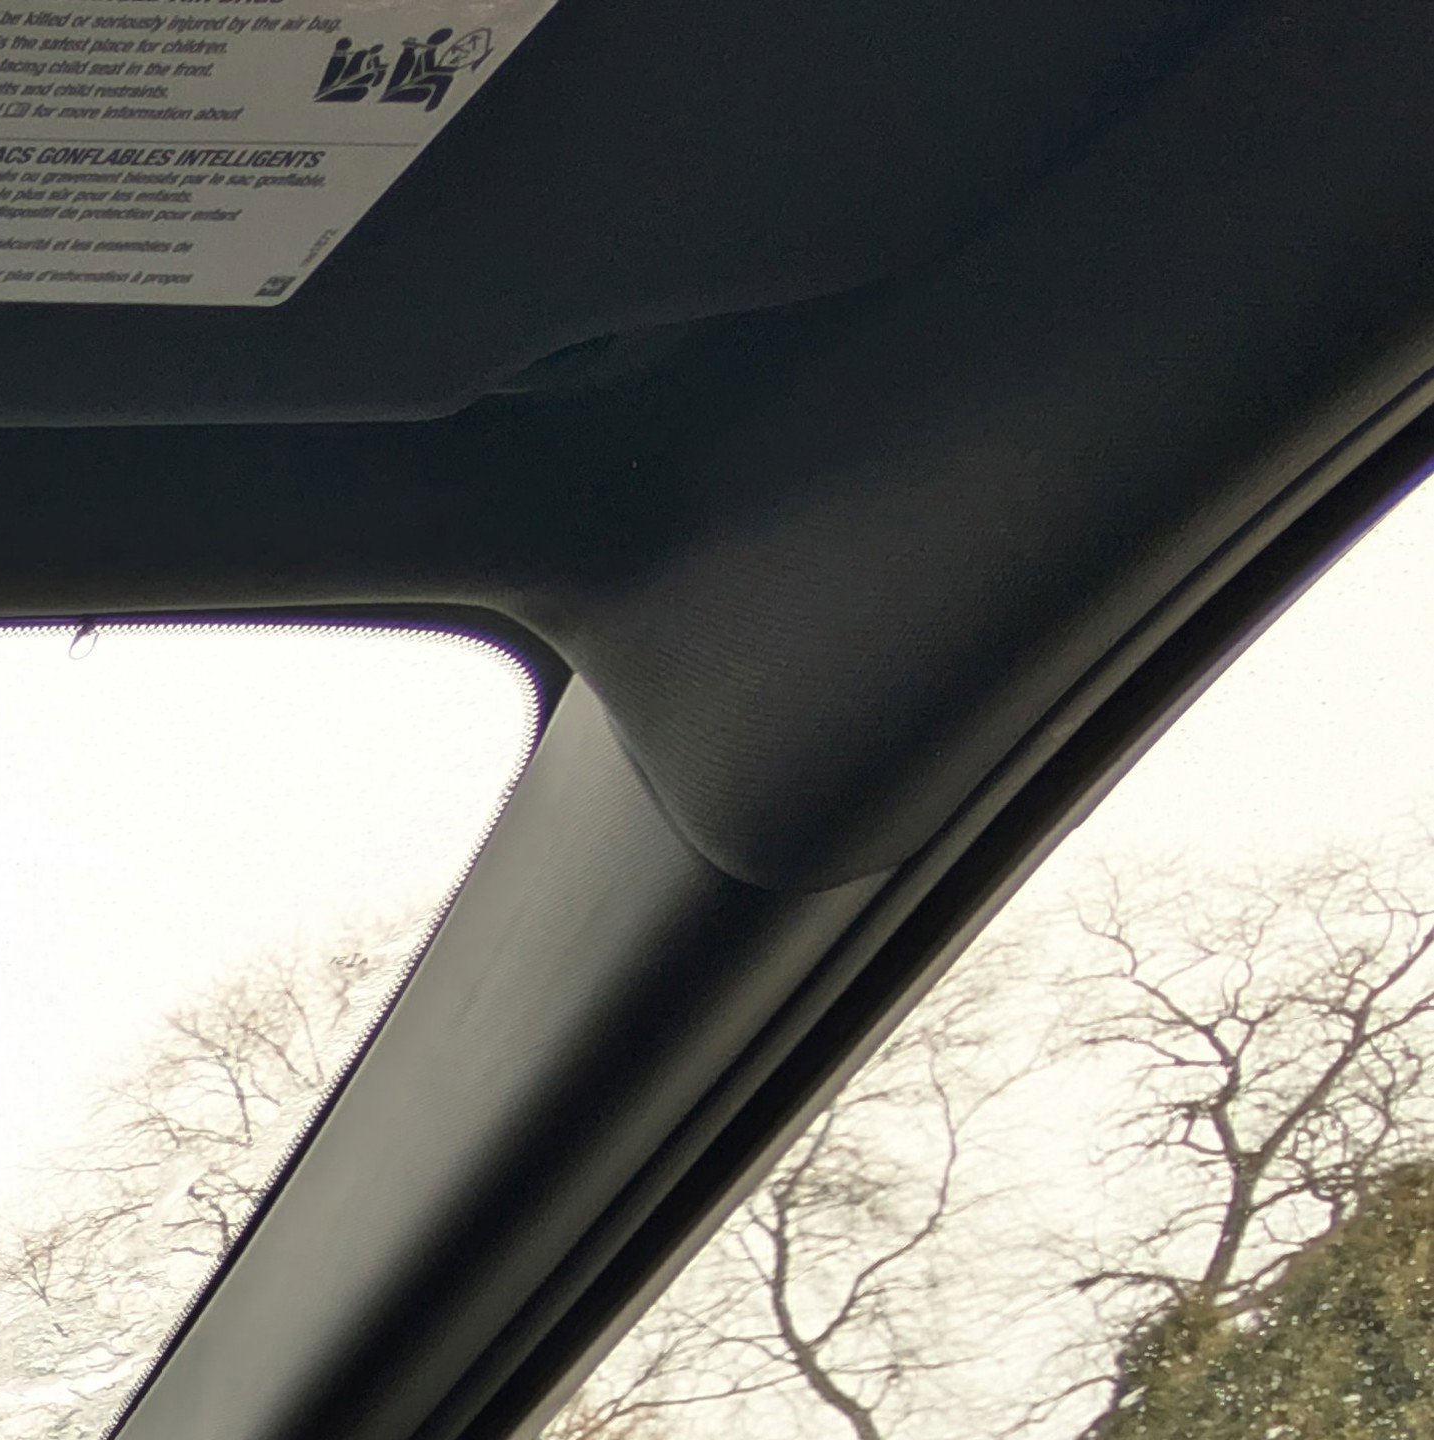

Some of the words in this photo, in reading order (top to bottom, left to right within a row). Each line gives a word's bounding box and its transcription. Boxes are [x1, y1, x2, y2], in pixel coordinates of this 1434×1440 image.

[0, 11, 22, 25] be
[24, 12, 73, 27] killed
[72, 17, 92, 27] or
[92, 16, 167, 32] seriously
[167, 16, 229, 32] injured
[227, 17, 252, 34] by
[251, 17, 282, 31] the
[281, 16, 308, 31] air
[10, 36, 38, 49] the
[39, 37, 91, 51] safest
[88, 39, 134, 54] place
[136, 40, 162, 52] for
[47, 62, 89, 74] child
[89, 62, 126, 76] seat
[126, 64, 144, 75] in
[144, 62, 172, 76] the
[20, 83, 55, 96] and
[53, 84, 96, 97] child
[32, 104, 58, 118] for
[57, 107, 102, 119] more
[100, 106, 194, 120] information
[192, 106, 244, 120] about
[36, 148, 177, 166] GONFLABLES
[173, 149, 327, 168] INTELLIGENTS
